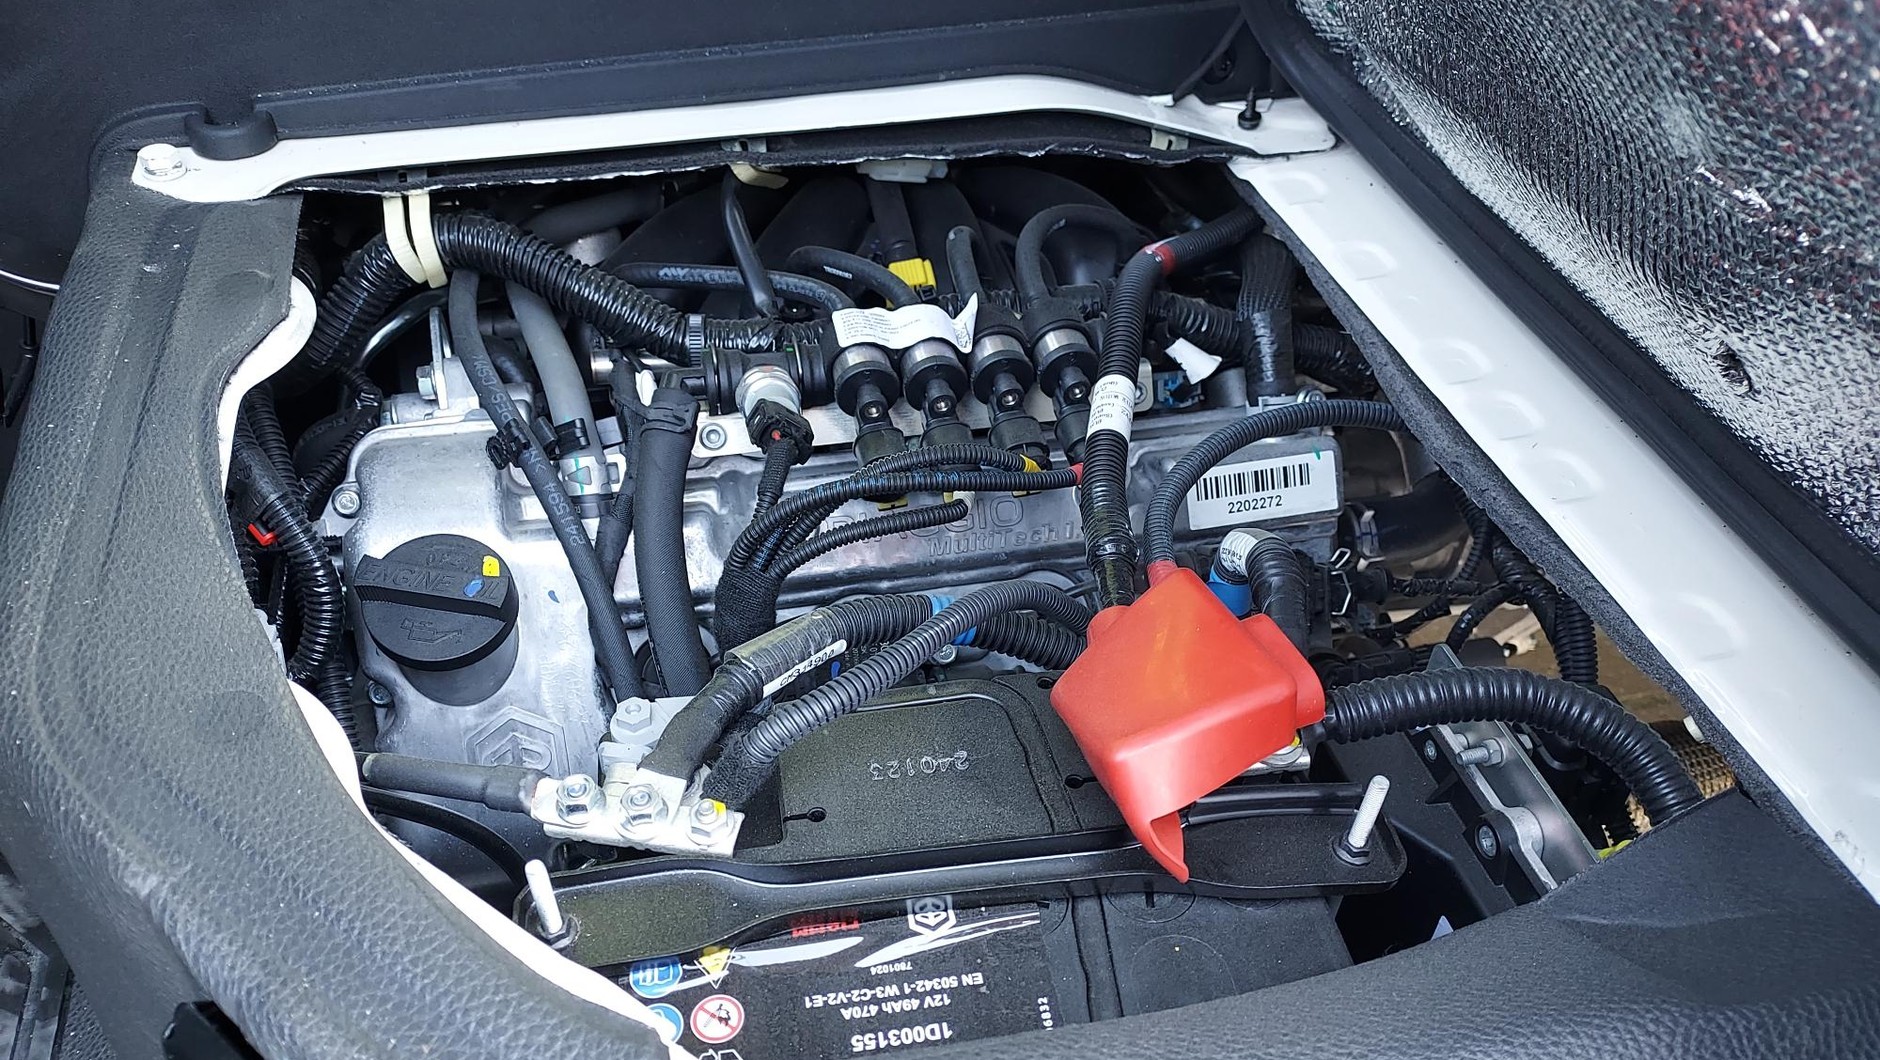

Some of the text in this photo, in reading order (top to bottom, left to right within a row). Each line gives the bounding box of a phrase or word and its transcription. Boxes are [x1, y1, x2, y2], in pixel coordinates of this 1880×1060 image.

[1228, 495, 1283, 514] 2202272
[929, 523, 1058, 557] MultiTech
[356, 563, 456, 592] ENGINE
[869, 750, 970, 780] 240123
[870, 961, 913, 975] 7801024
[805, 972, 983, 1008] EN 50342-1 W3-C2-V2-E1
[840, 994, 951, 1020] 12V 49Ah 470A
[851, 1021, 953, 1053] 1D003155
